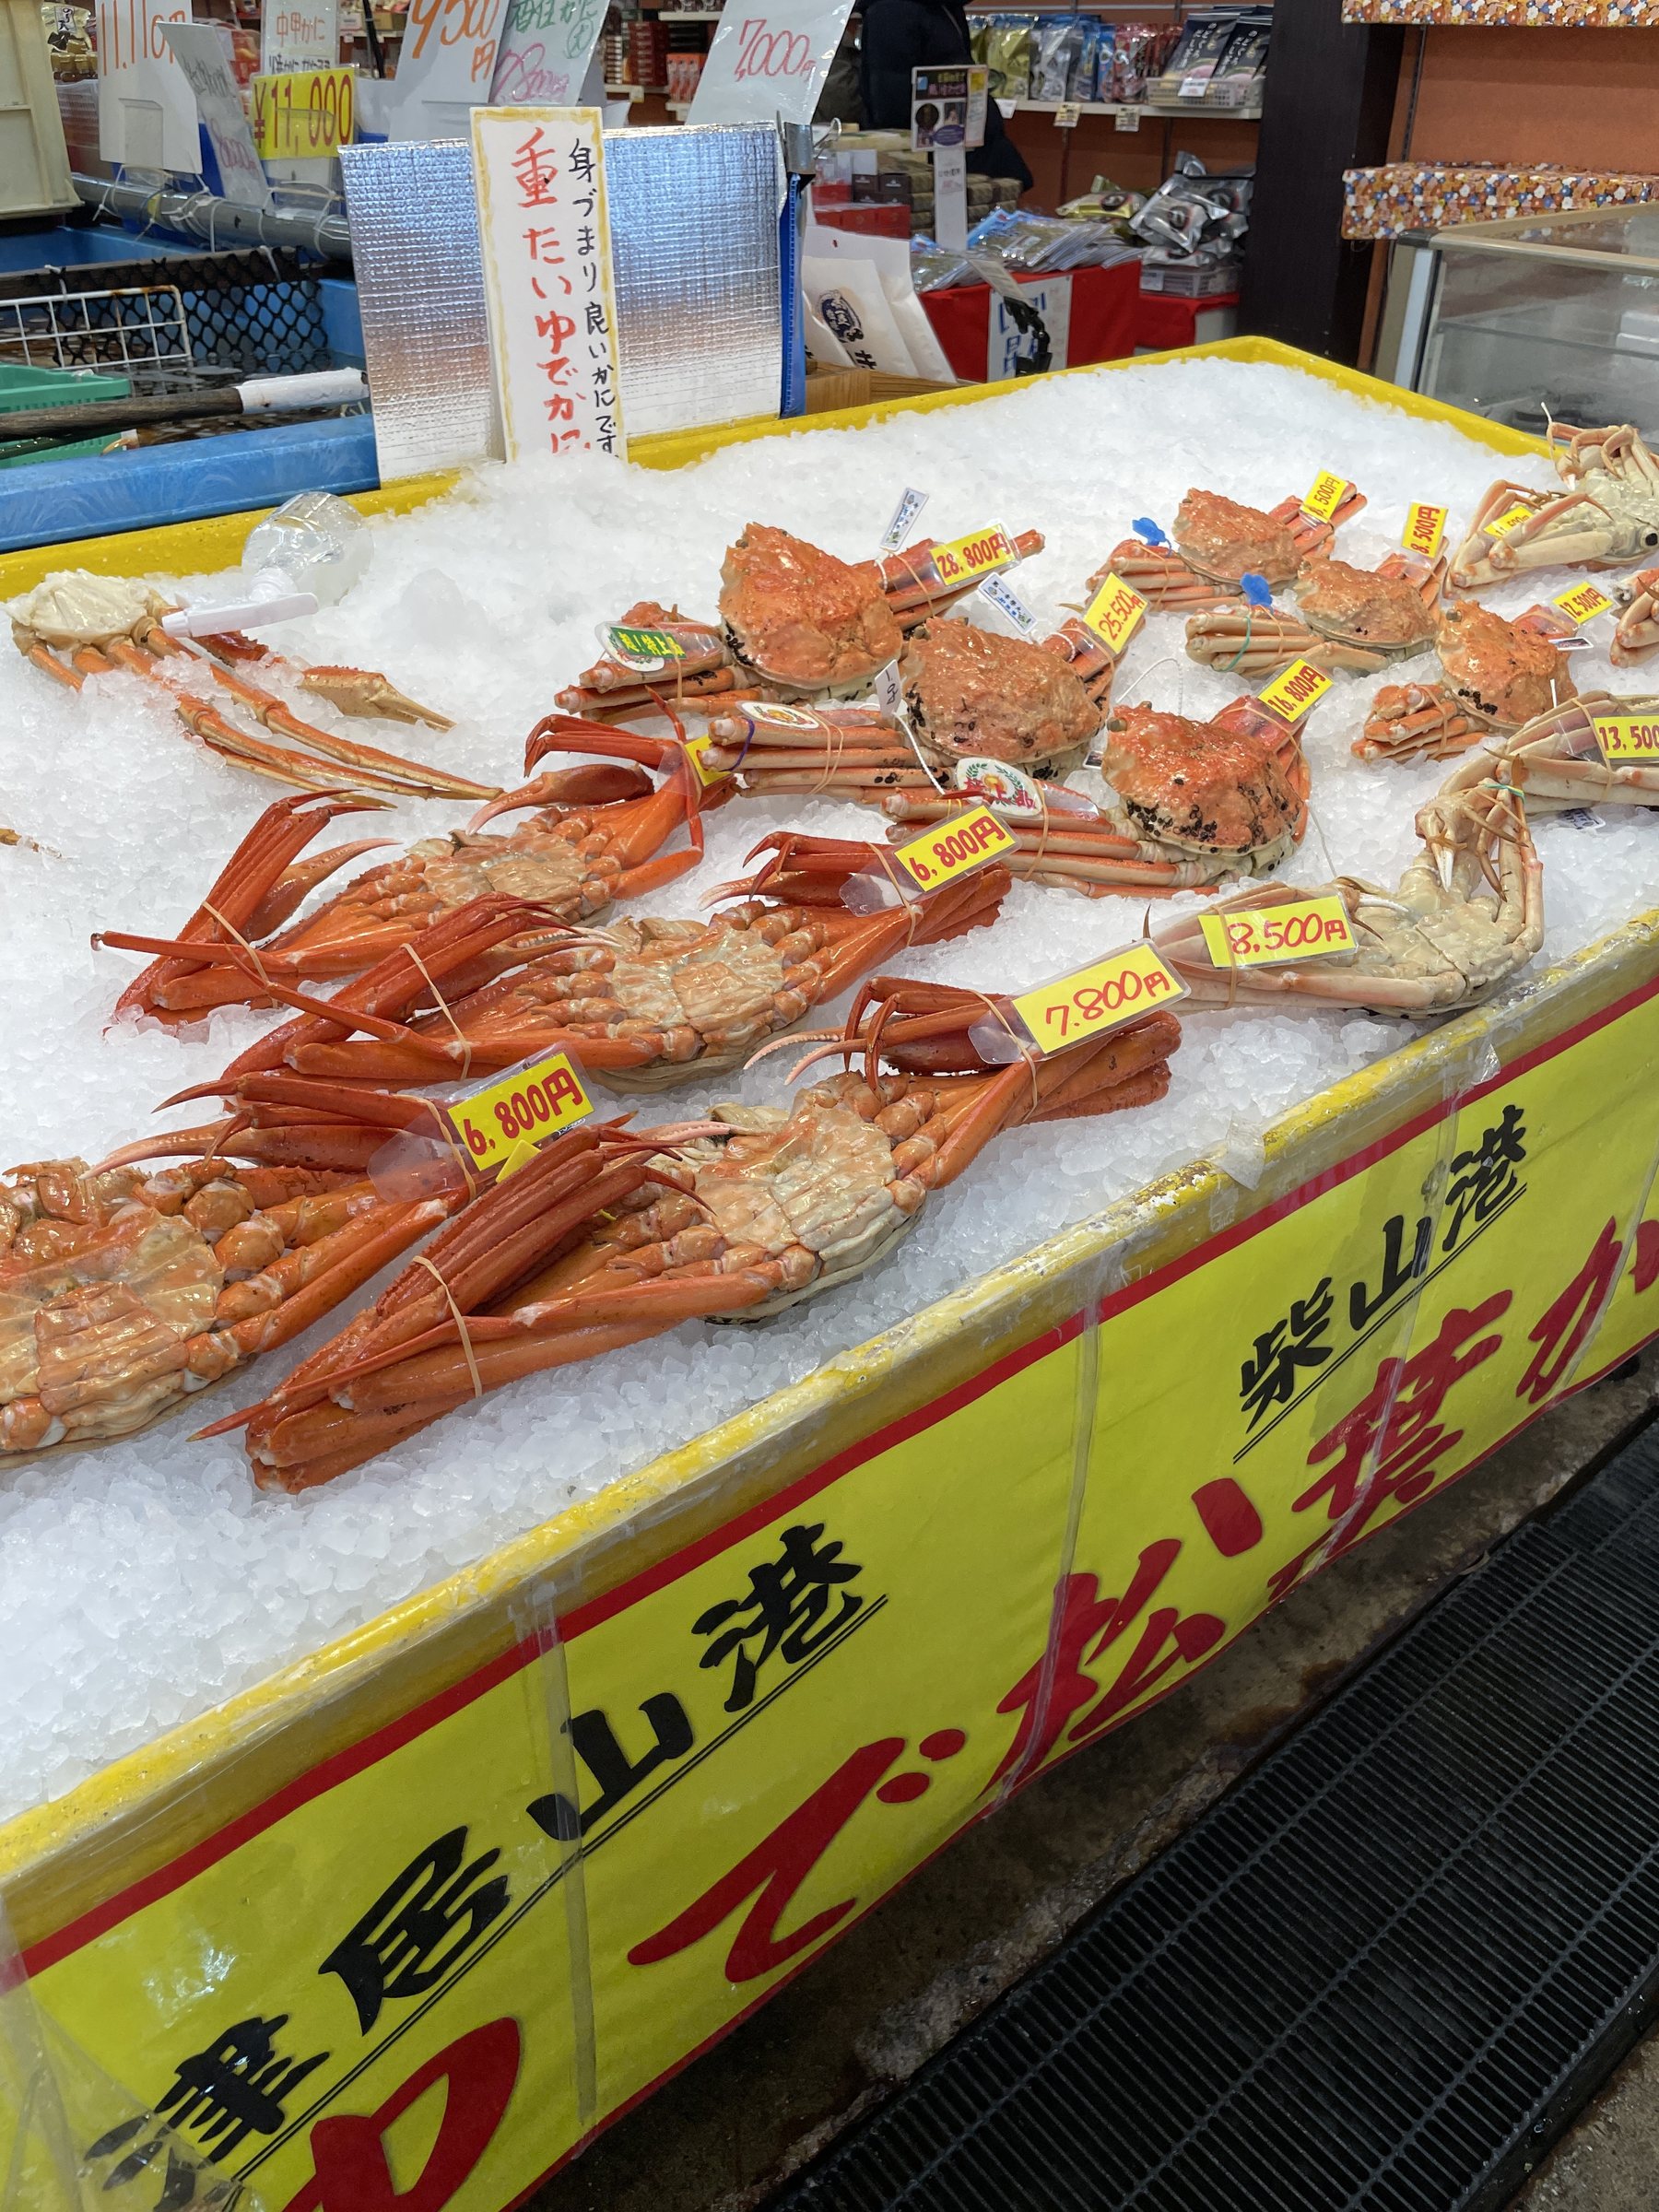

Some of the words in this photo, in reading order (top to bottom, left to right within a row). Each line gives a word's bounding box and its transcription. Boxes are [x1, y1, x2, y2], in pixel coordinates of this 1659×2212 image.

[935, 532, 1012, 579] 28,800円
[1267, 665, 1326, 716] 16,800円
[909, 815, 1006, 882] 6,800円
[463, 1067, 583, 1157] 6,800円
[1240, 1104, 1527, 1434] 柴山港
